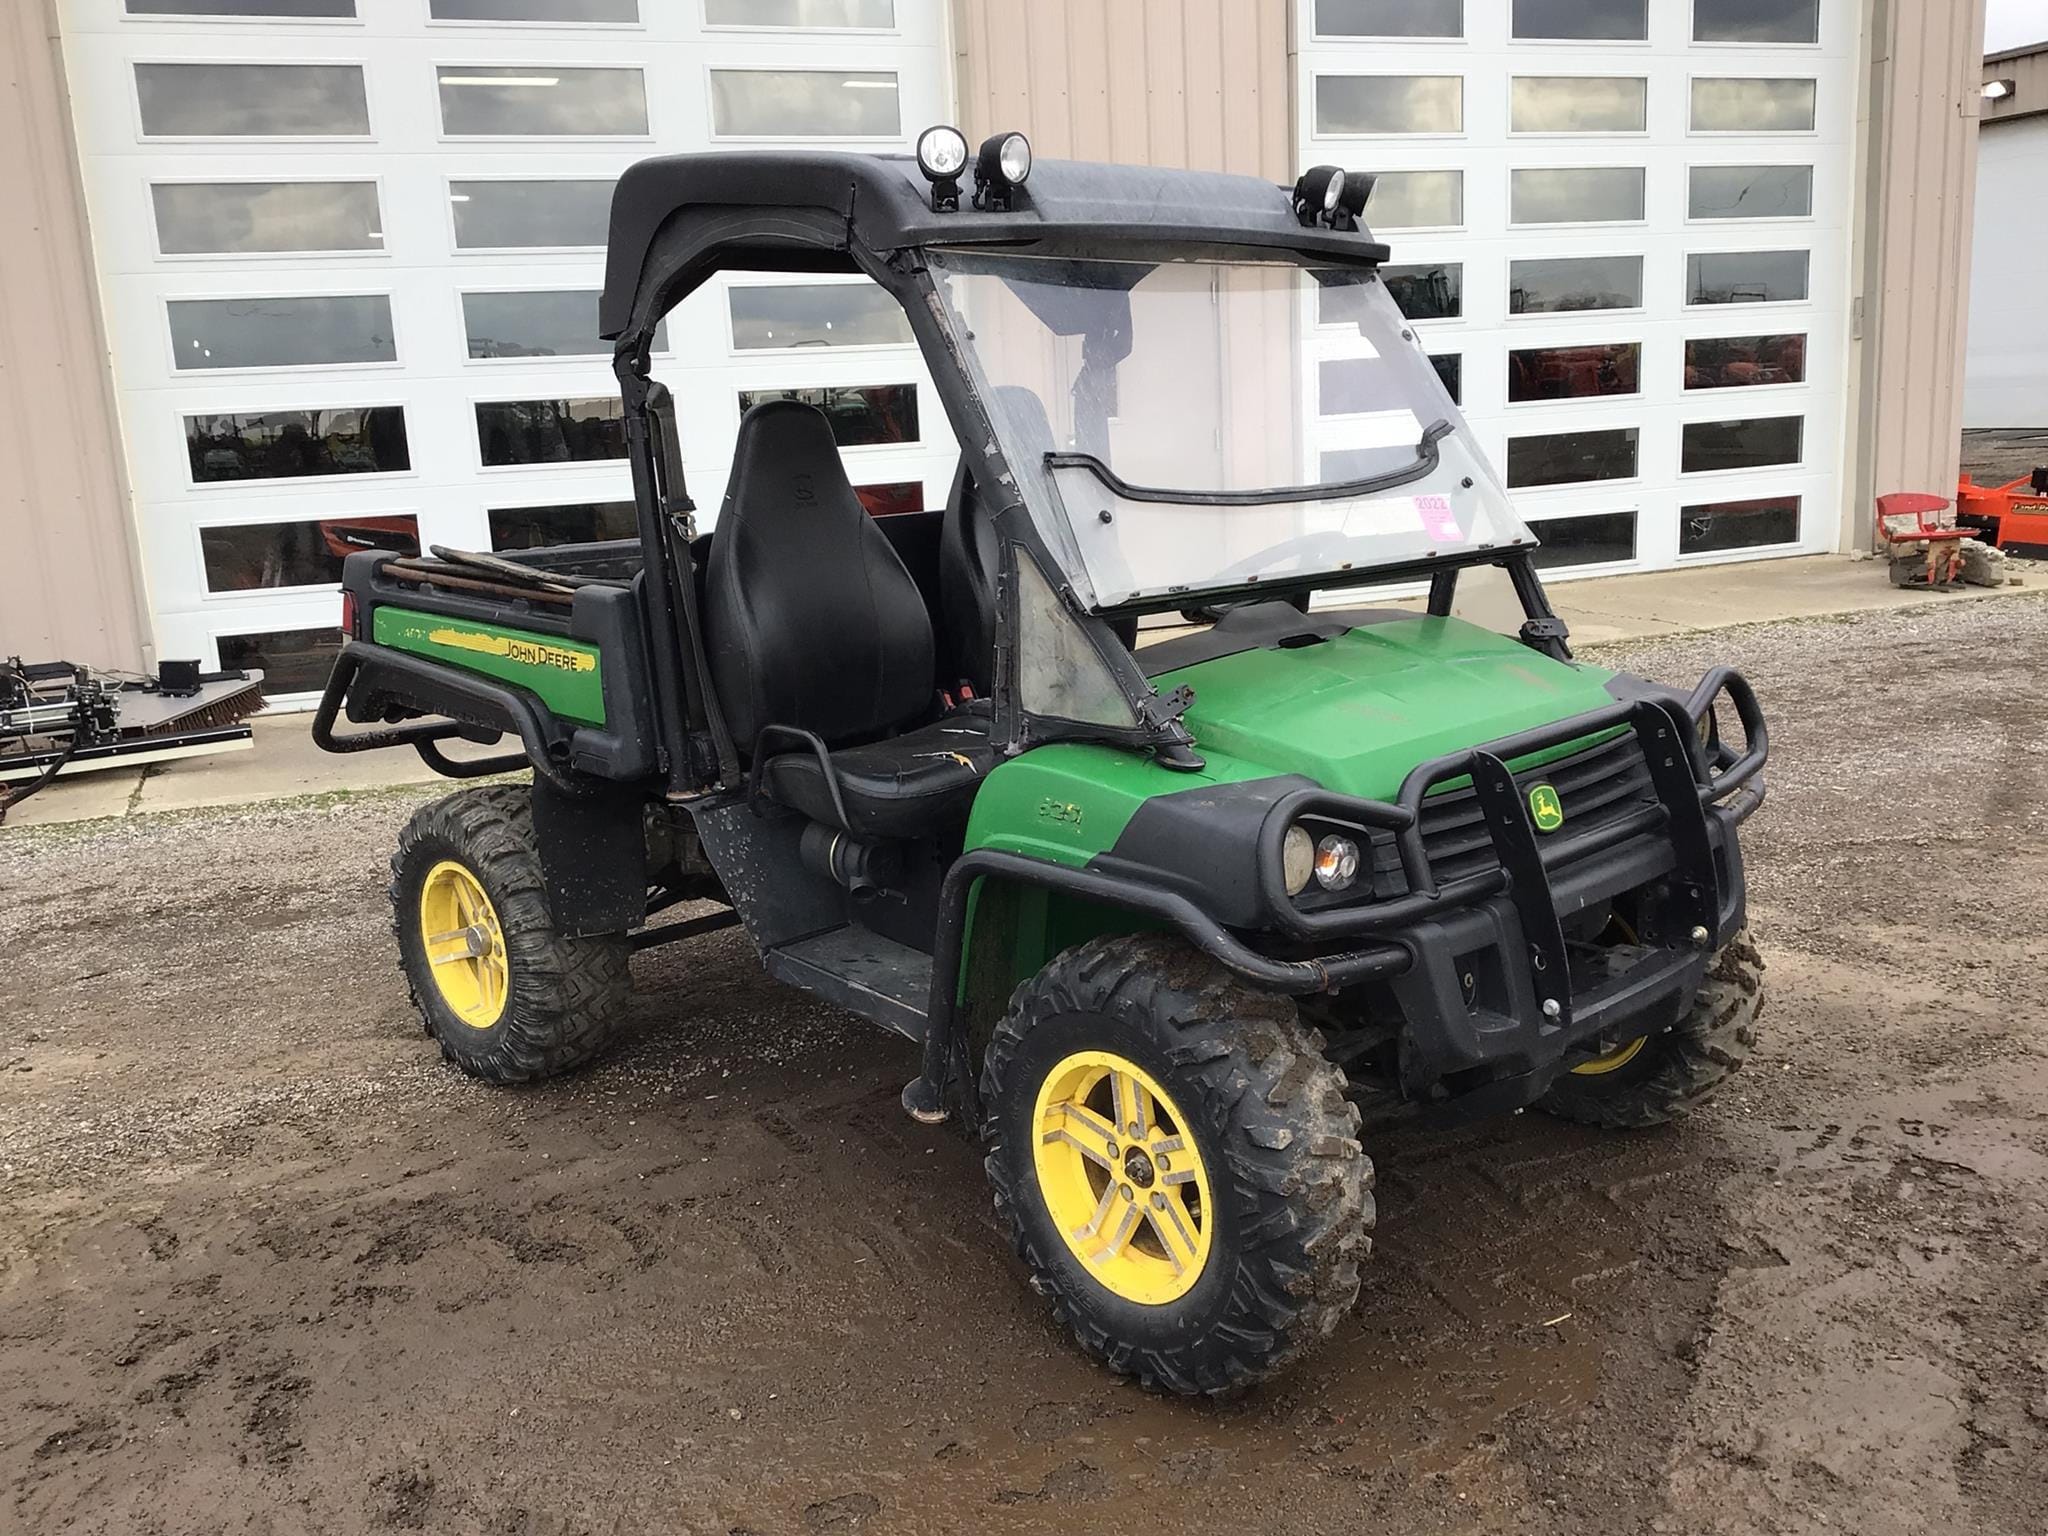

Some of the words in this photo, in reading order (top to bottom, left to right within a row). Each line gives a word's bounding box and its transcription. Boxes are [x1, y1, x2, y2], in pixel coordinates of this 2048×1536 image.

[1416, 497, 1448, 510] 2022
[505, 640, 536, 664] JOHN
[538, 647, 578, 671] DEERE
